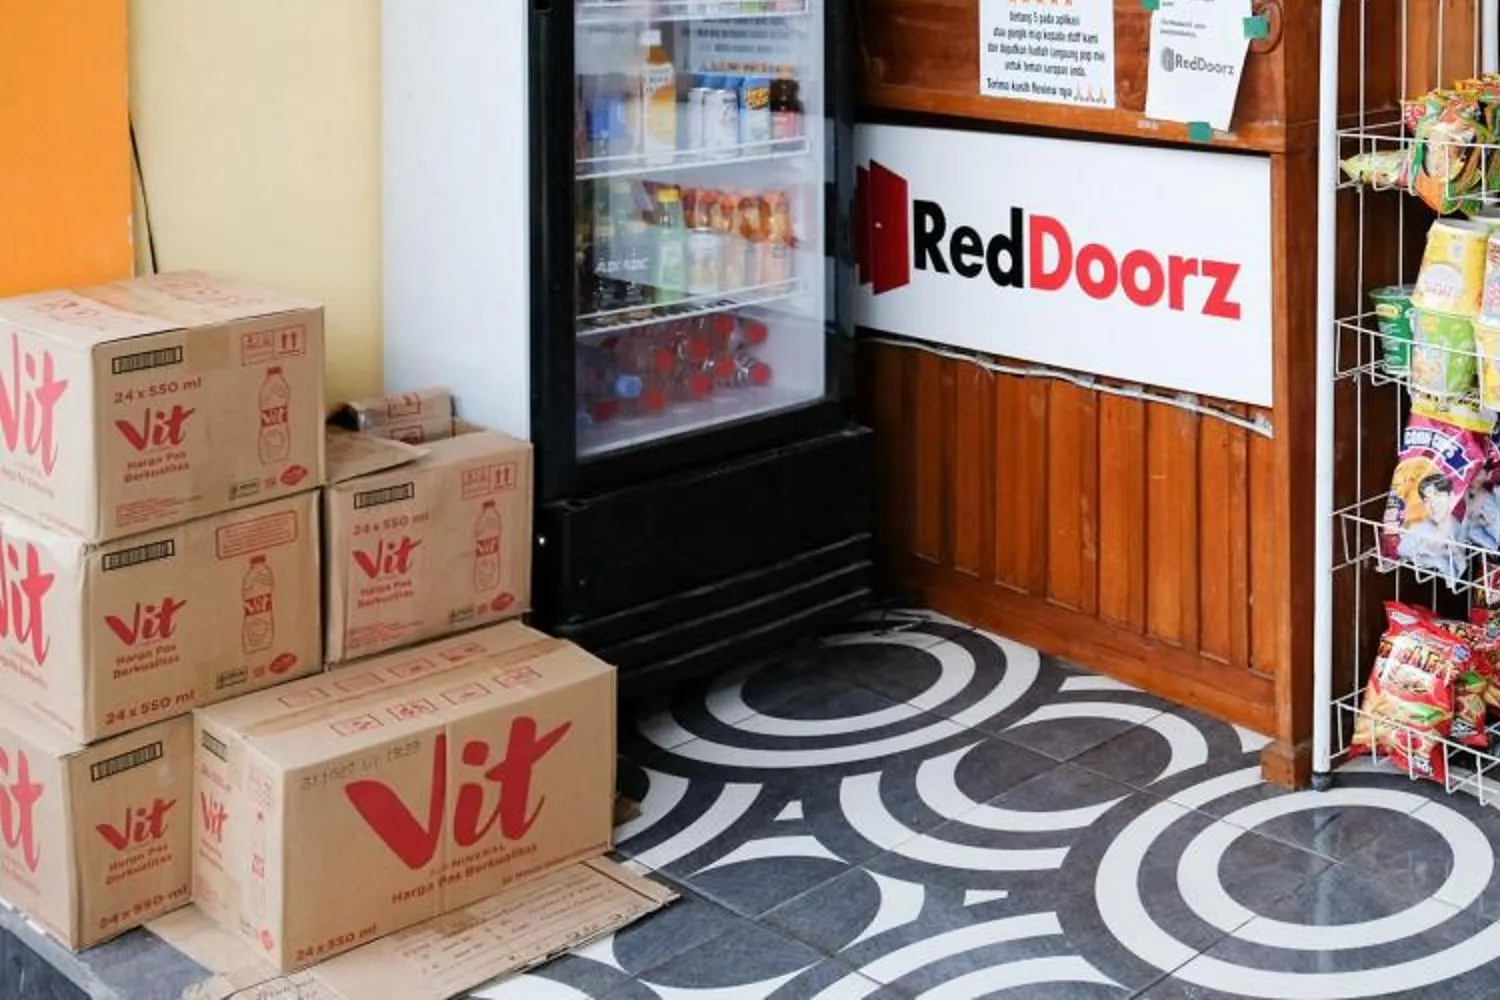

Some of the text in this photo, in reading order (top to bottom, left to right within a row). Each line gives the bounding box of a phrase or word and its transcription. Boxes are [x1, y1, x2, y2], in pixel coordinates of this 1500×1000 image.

[1175, 53, 1235, 75] RedDoorz
[913, 200, 1241, 320] RedDoorz
[114, 387, 133, 404] 24
[149, 381, 178, 398] 550
[183, 377, 203, 391] ml
[115, 405, 196, 451] Vit
[352, 535, 423, 579] Vit
[104, 597, 188, 646] Vit
[344, 715, 573, 870] Vit
[96, 798, 176, 850] Vit
[438, 872, 462, 889] Pas
